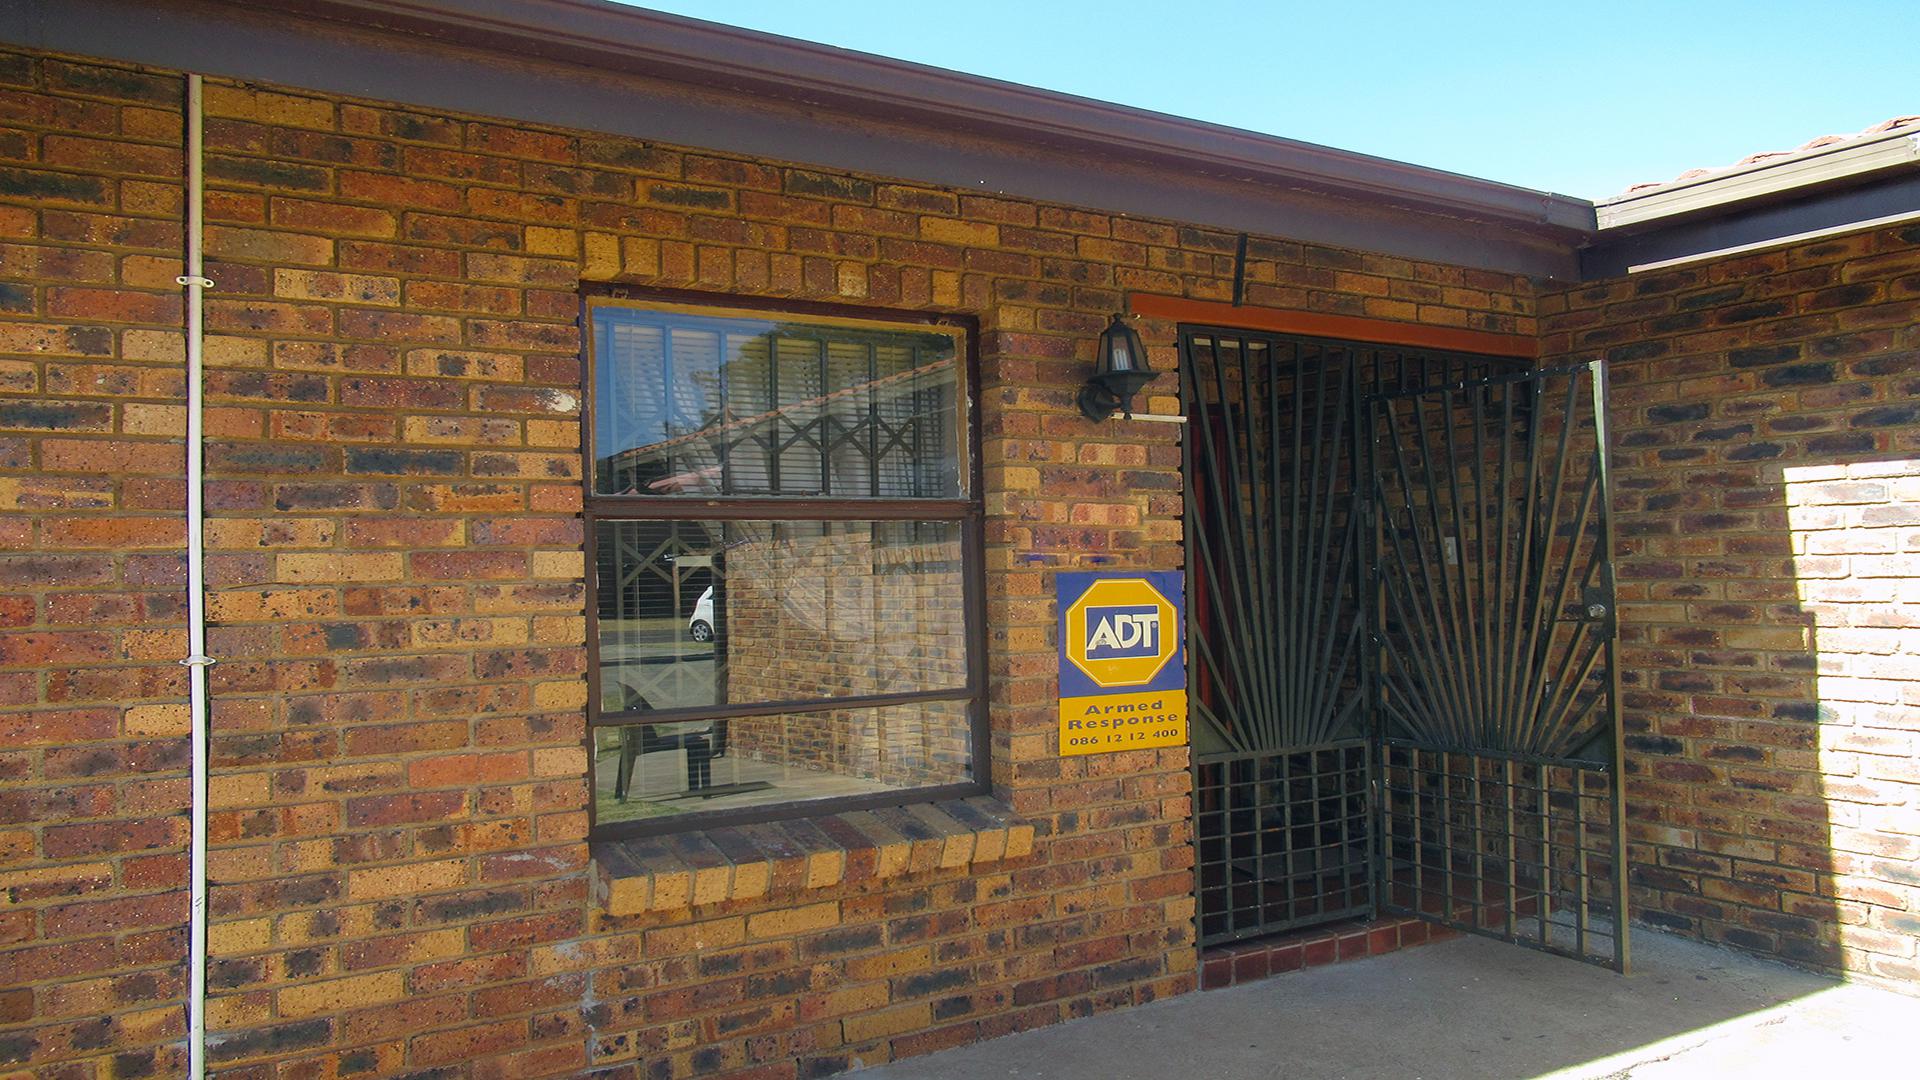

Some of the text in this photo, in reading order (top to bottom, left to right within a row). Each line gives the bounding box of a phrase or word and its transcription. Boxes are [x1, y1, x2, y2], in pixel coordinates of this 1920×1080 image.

[1087, 614, 1158, 650] ADT
[1085, 700, 1163, 715] Armed
[1068, 713, 1178, 730] Response
[1070, 729, 1178, 746] 086 12 12 400
